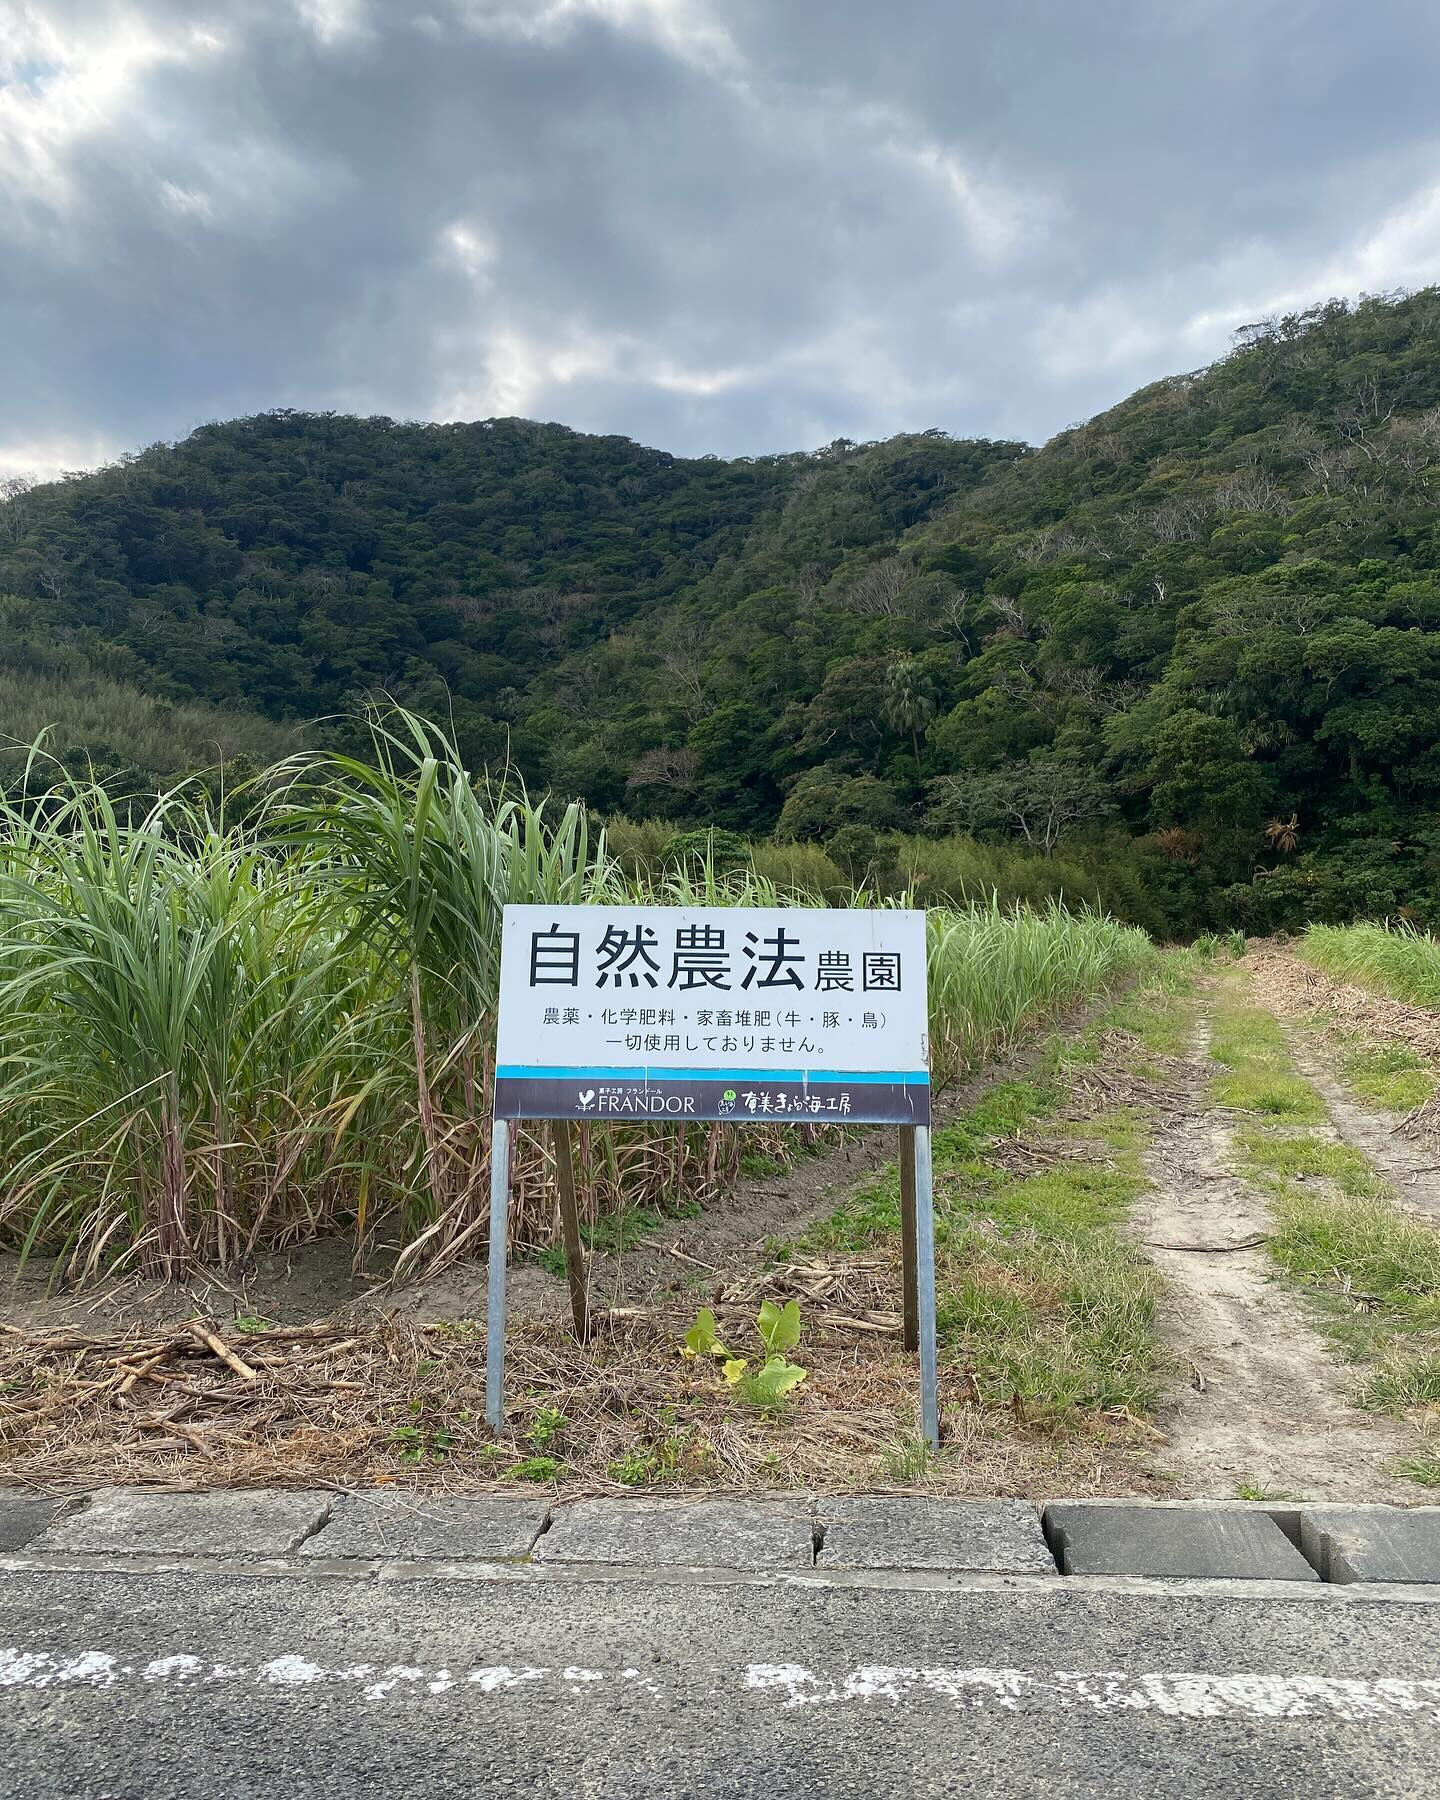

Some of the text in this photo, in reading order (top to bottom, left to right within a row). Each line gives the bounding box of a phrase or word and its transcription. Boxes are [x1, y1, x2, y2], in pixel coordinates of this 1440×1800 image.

[605, 1033, 826, 1054] 一切使用しておりません。
[598, 1095, 696, 1113] FRANDOR
